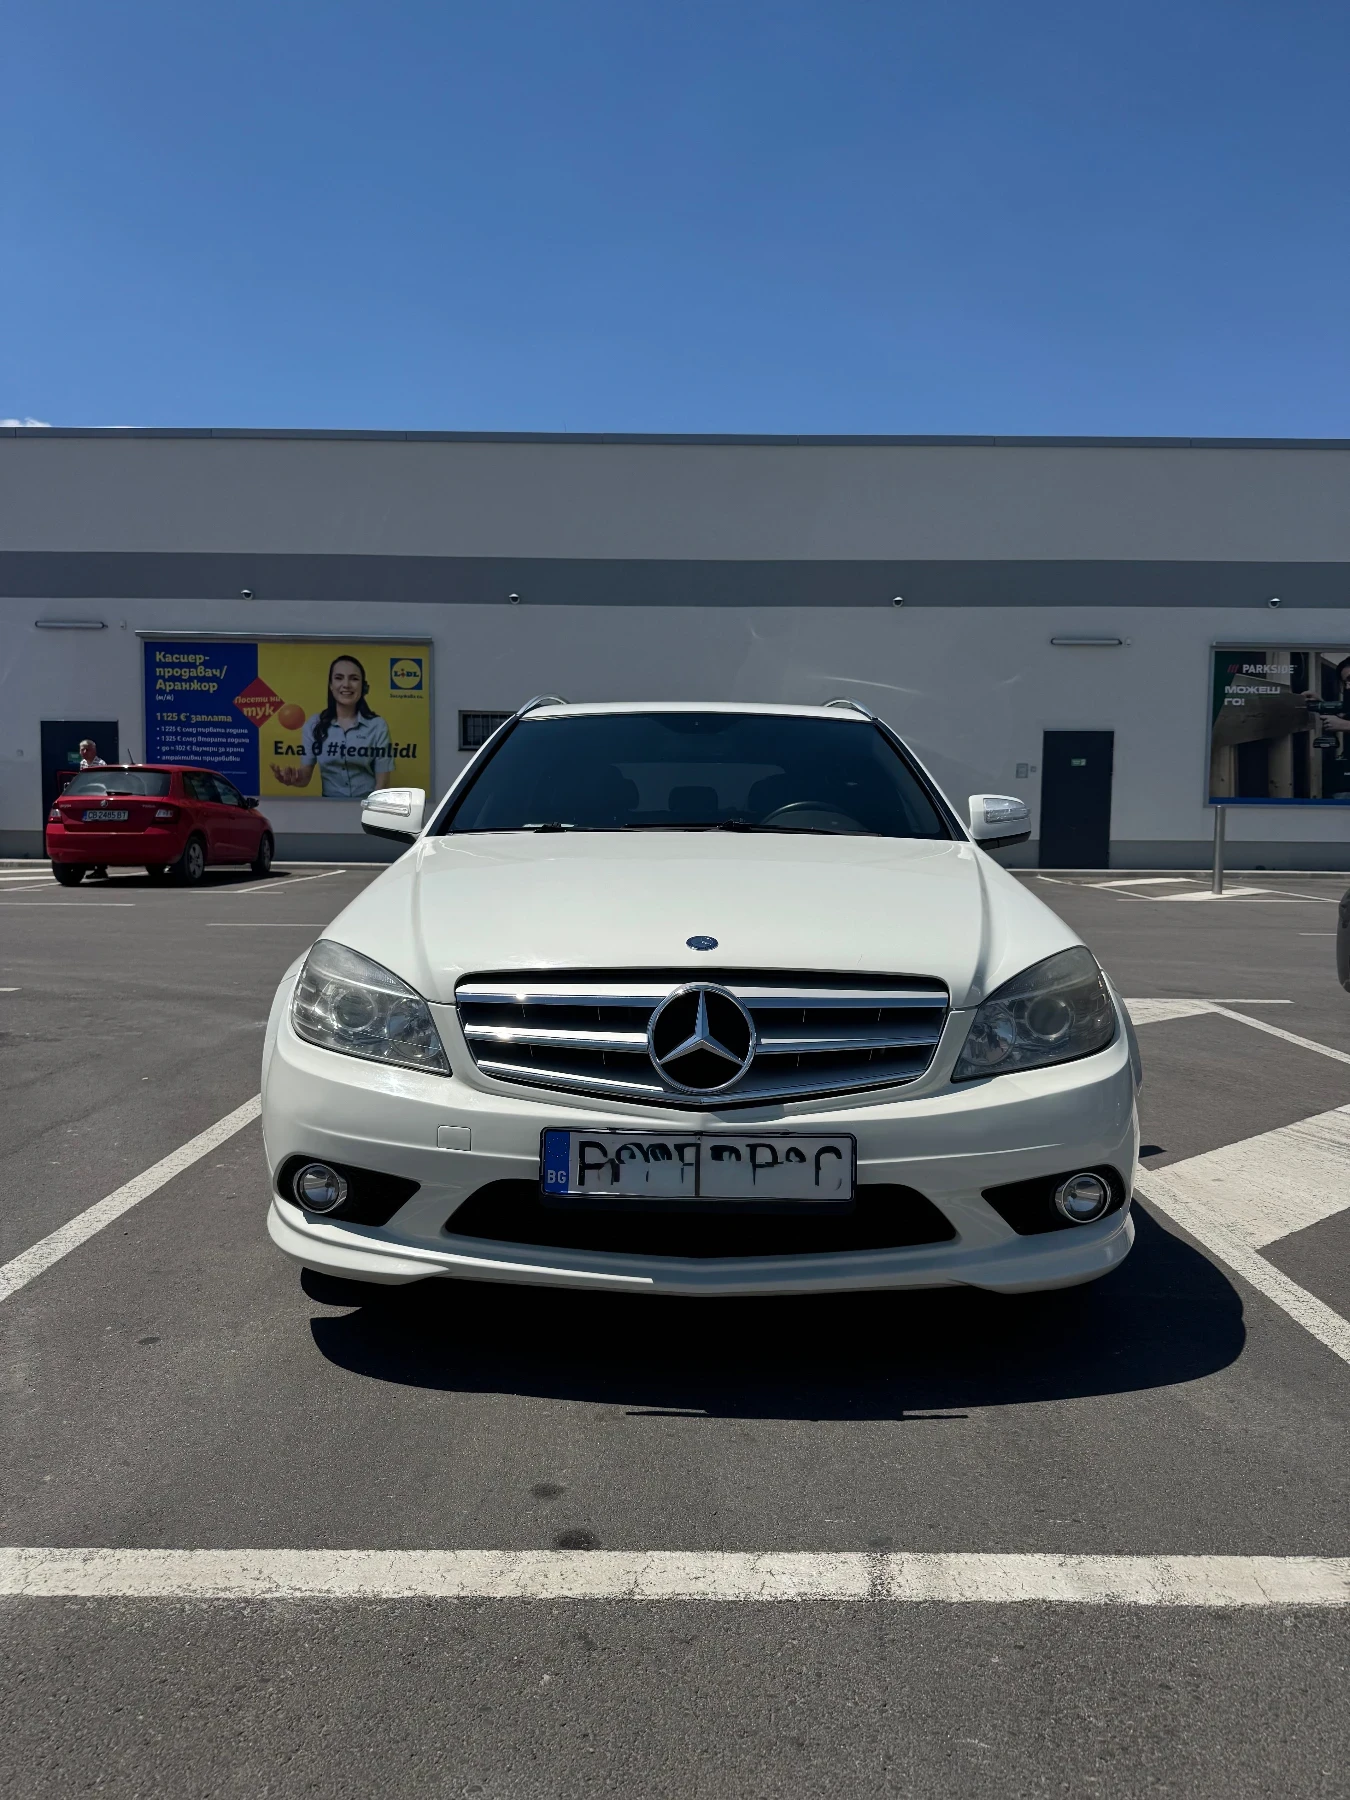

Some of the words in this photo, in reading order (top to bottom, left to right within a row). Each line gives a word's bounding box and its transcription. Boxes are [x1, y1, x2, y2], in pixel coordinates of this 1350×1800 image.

[155, 651, 210, 665] Касиер-
[155, 665, 228, 679] продавач/
[1242, 664, 1295, 674] PARKSIDE
[155, 679, 218, 693] Аранжор
[1224, 685, 1281, 694] МОЖЕШ
[234, 696, 269, 704] Посети
[1224, 697, 1245, 706] ГО!
[243, 703, 274, 720] тук
[190, 714, 233, 723] заплата
[192, 745, 218, 753] ваучери
[273, 740, 307, 756] Ела
[311, 741, 323, 757] в
[326, 741, 417, 759] #teamlidl
[547, 1170, 567, 1184] BG
